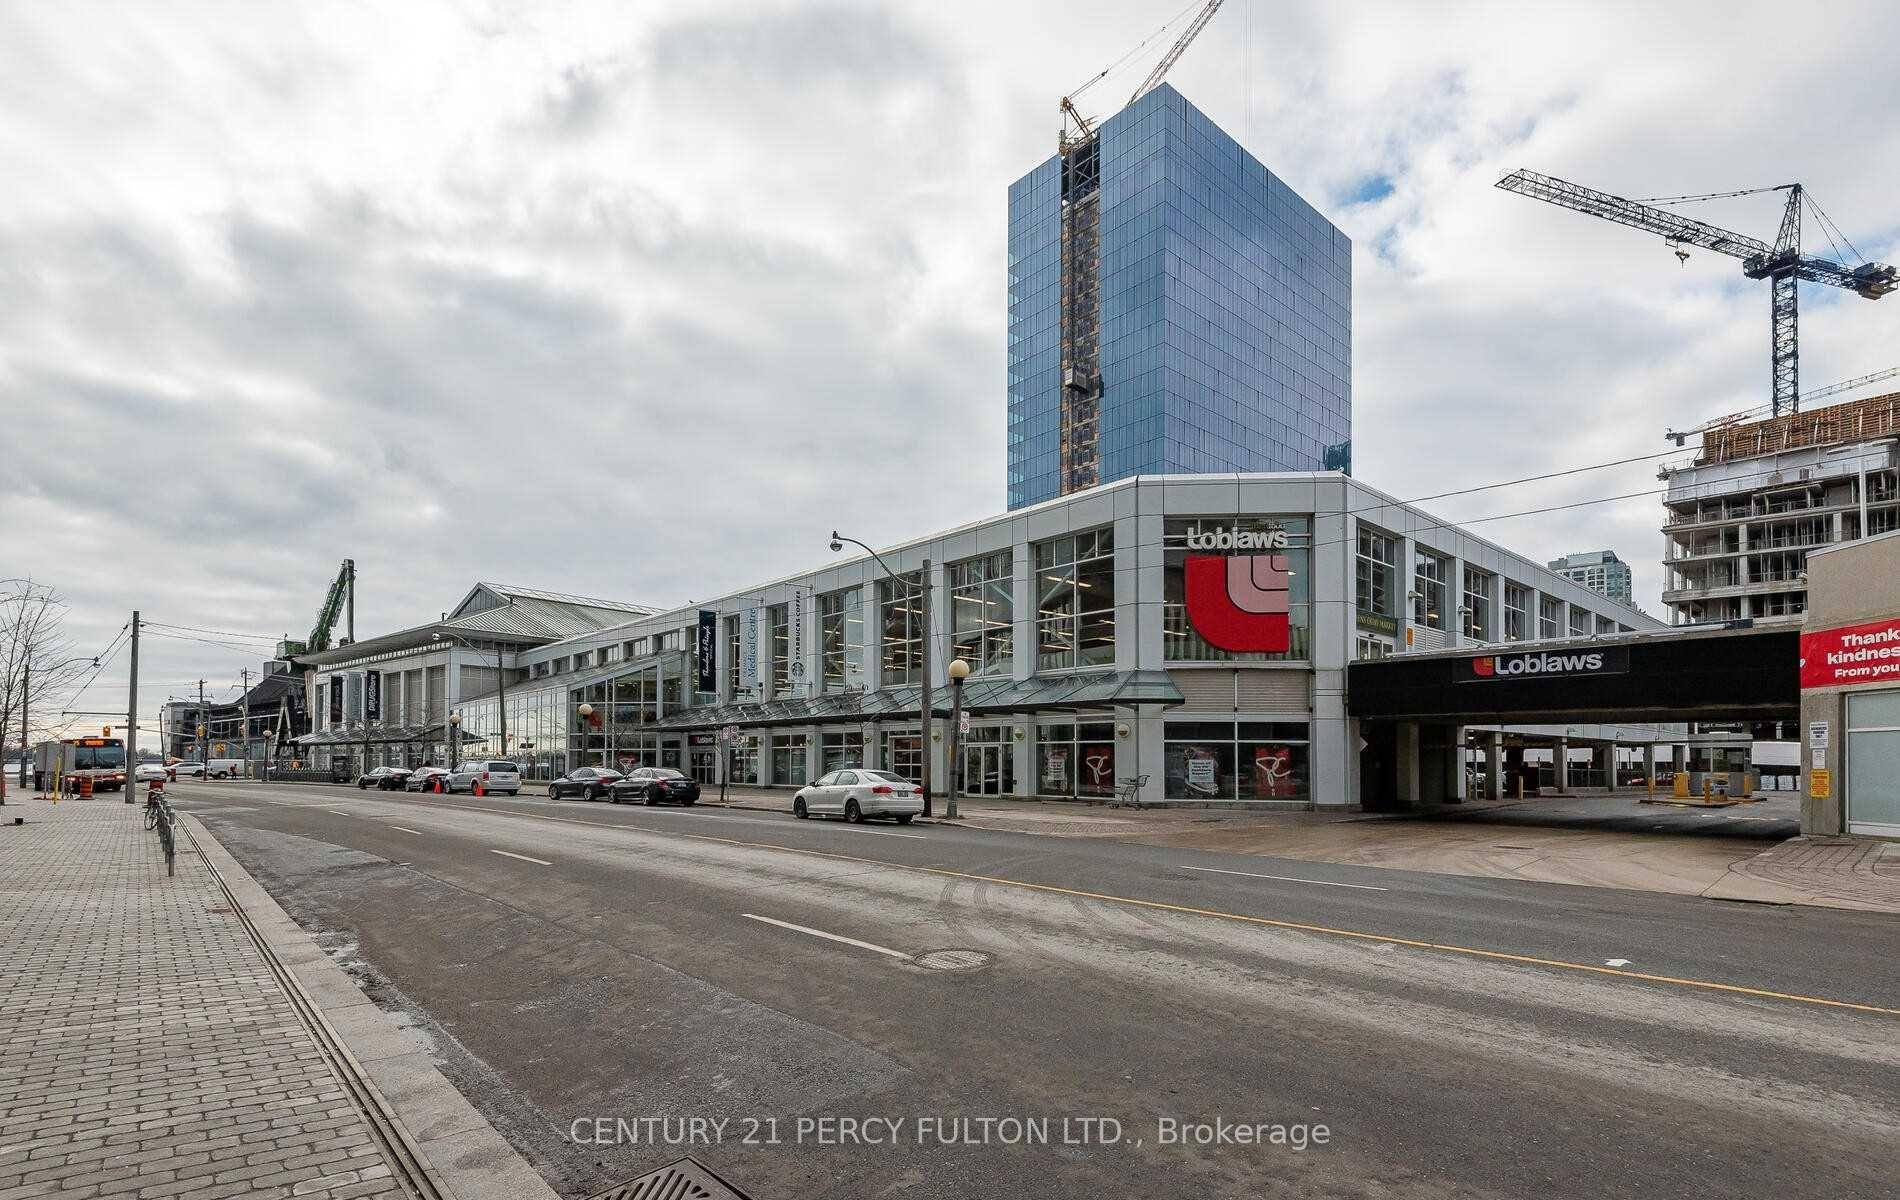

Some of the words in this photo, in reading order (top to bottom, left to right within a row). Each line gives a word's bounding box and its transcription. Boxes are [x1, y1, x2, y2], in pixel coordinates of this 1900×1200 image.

[1188, 526, 1289, 549] Loblaws
[748, 608, 756, 640] Centre
[1841, 628, 1900, 647] Thank
[748, 642, 756, 678] Medical
[1495, 653, 1604, 675] Loblaws
[1834, 666, 1871, 679] From
